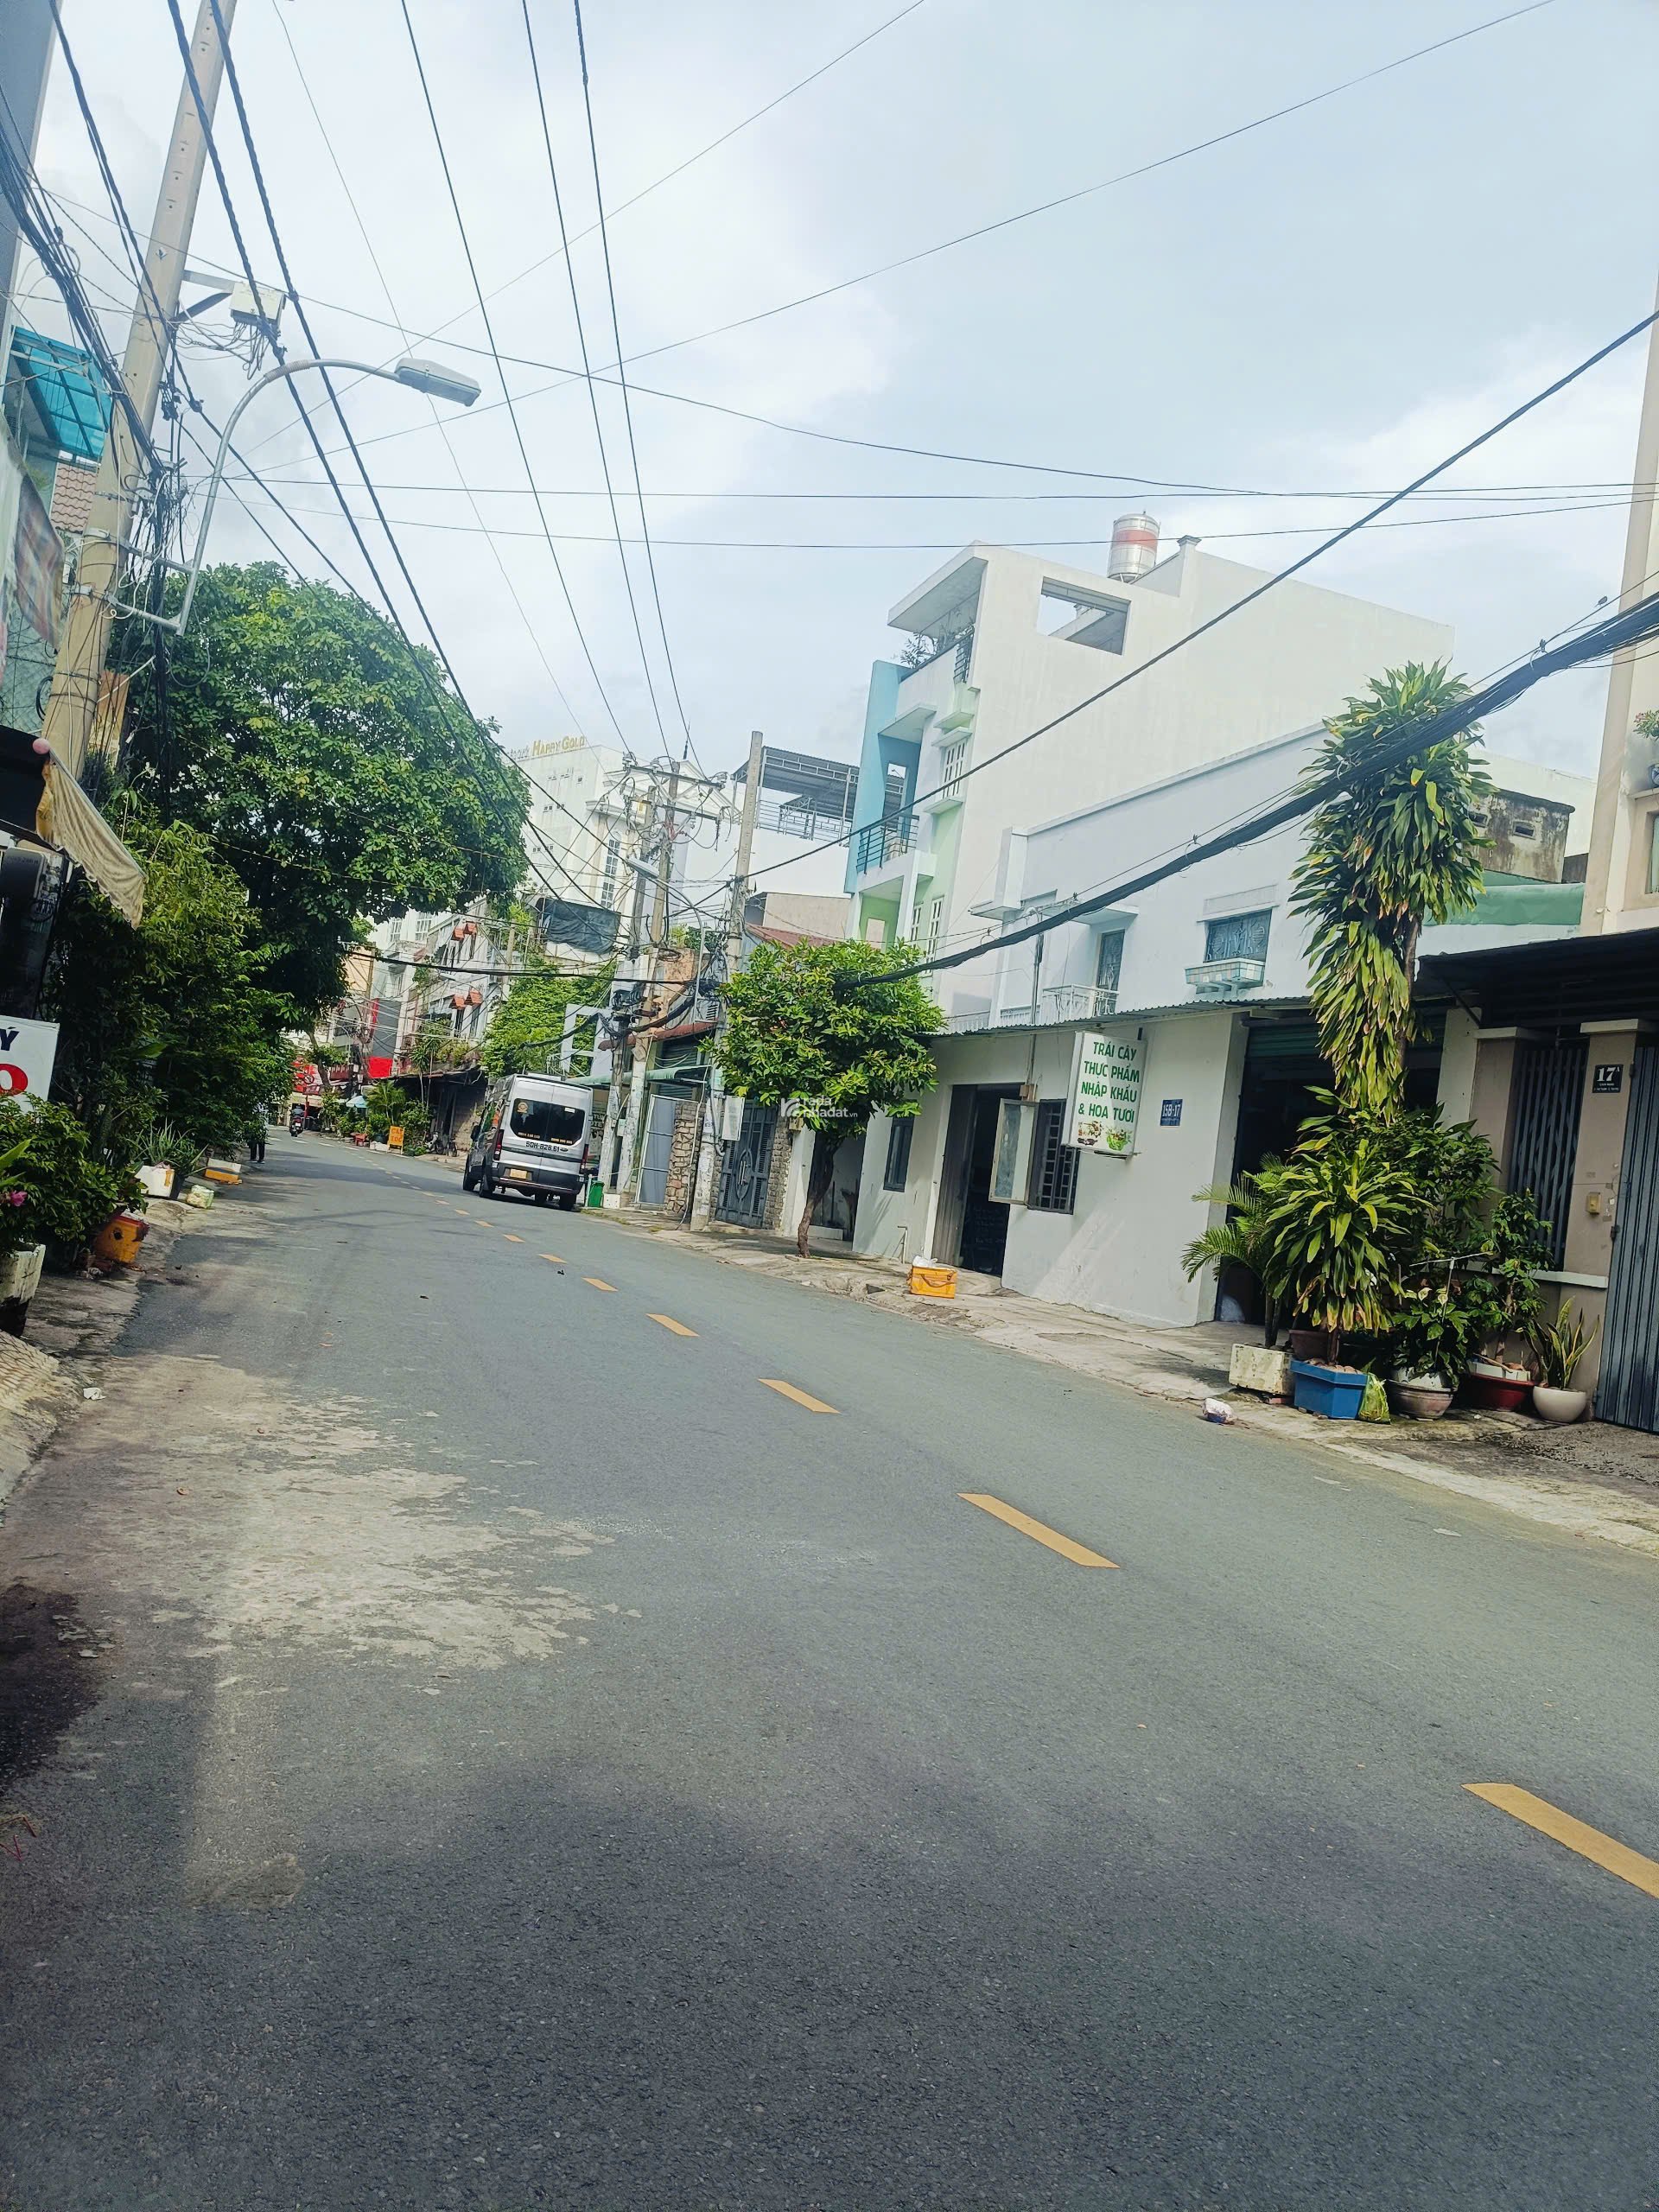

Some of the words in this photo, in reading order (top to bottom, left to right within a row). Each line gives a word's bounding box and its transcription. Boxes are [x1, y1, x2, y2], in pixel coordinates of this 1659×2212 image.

[1093, 1041, 1115, 1058] TRÁI
[1117, 1045, 1136, 1061] CÂY
[1084, 1061, 1108, 1079] THỰC
[1111, 1064, 1140, 1083] PHẨM
[1081, 1081, 1108, 1099] NHẬP
[1110, 1084, 1137, 1103] KHẨU
[1078, 1103, 1085, 1115] &
[1089, 1103, 1108, 1119] HOA
[1113, 1107, 1135, 1123] TƯƠI
